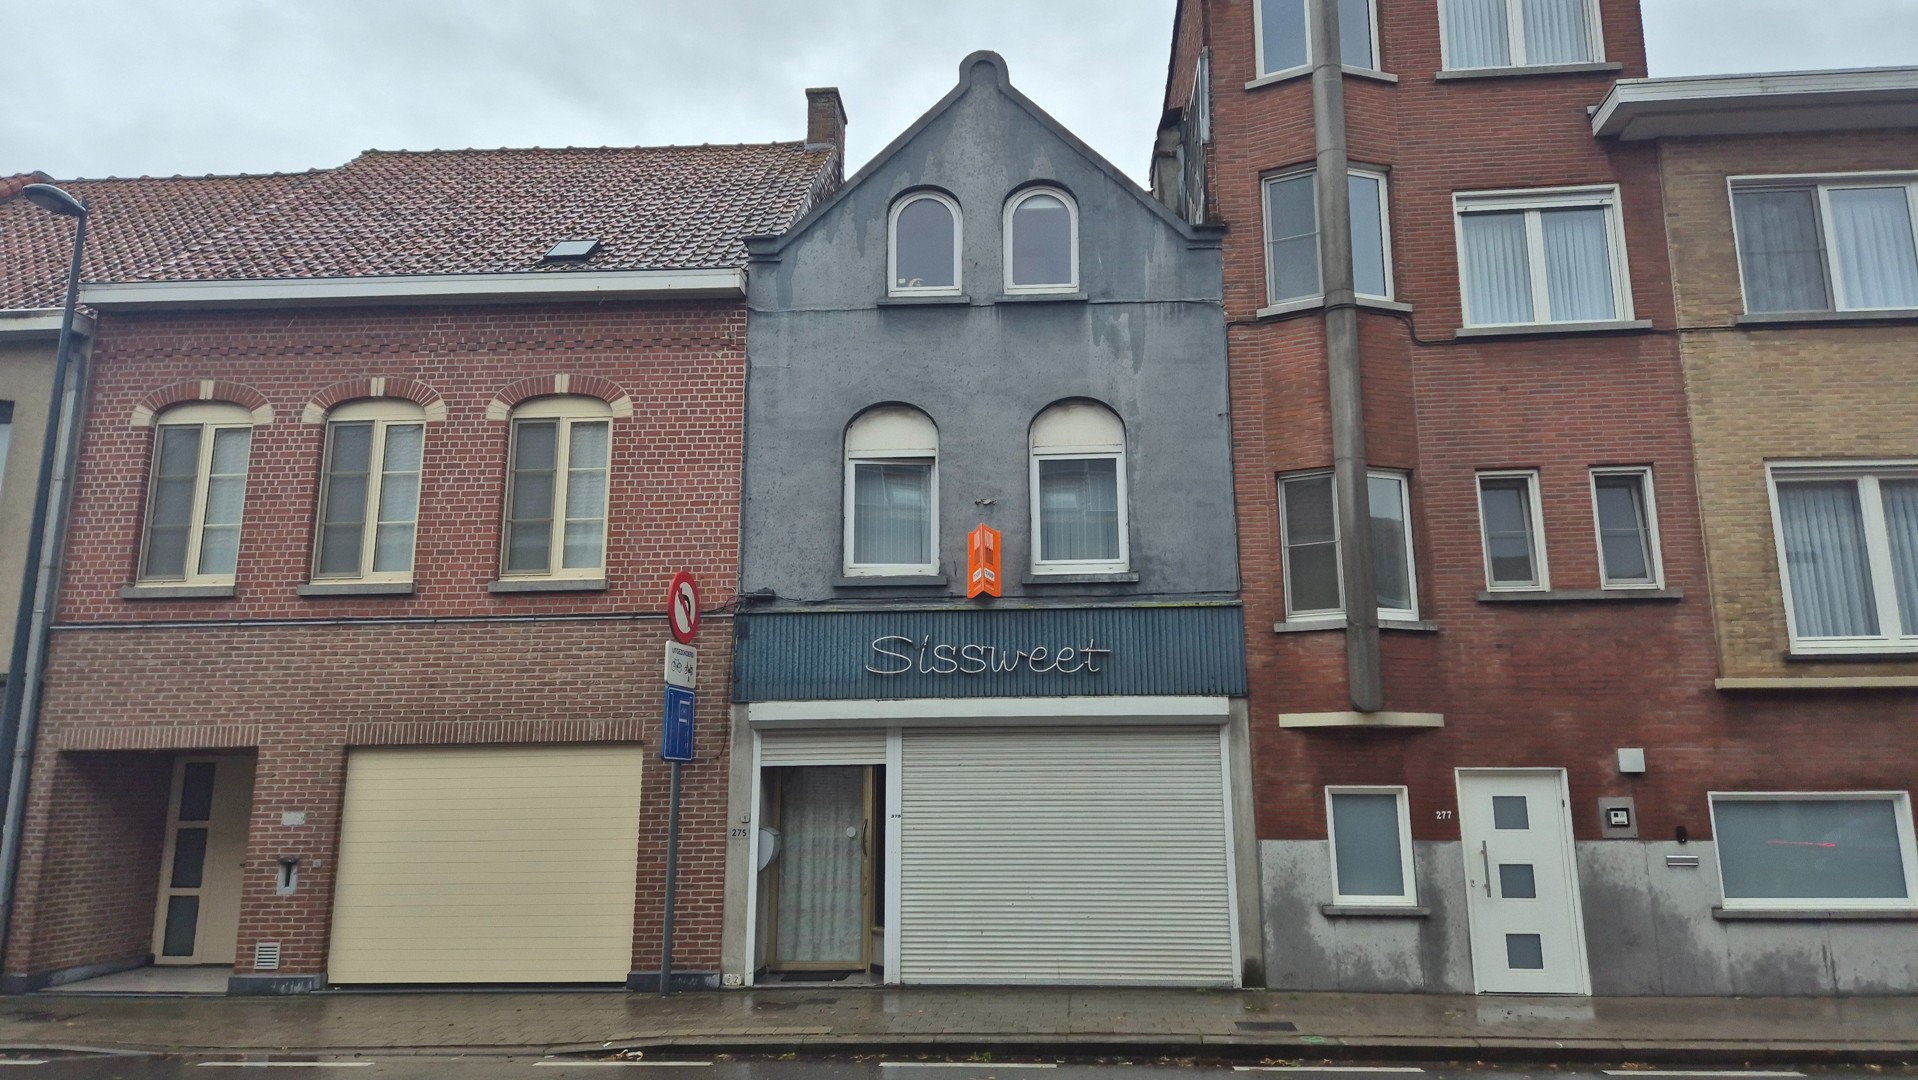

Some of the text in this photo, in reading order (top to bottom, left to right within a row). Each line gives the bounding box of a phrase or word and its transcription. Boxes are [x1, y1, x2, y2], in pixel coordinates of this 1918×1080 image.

[865, 634, 1111, 674] Sissweet
[1435, 810, 1452, 820] 277
[731, 828, 747, 837] 275
